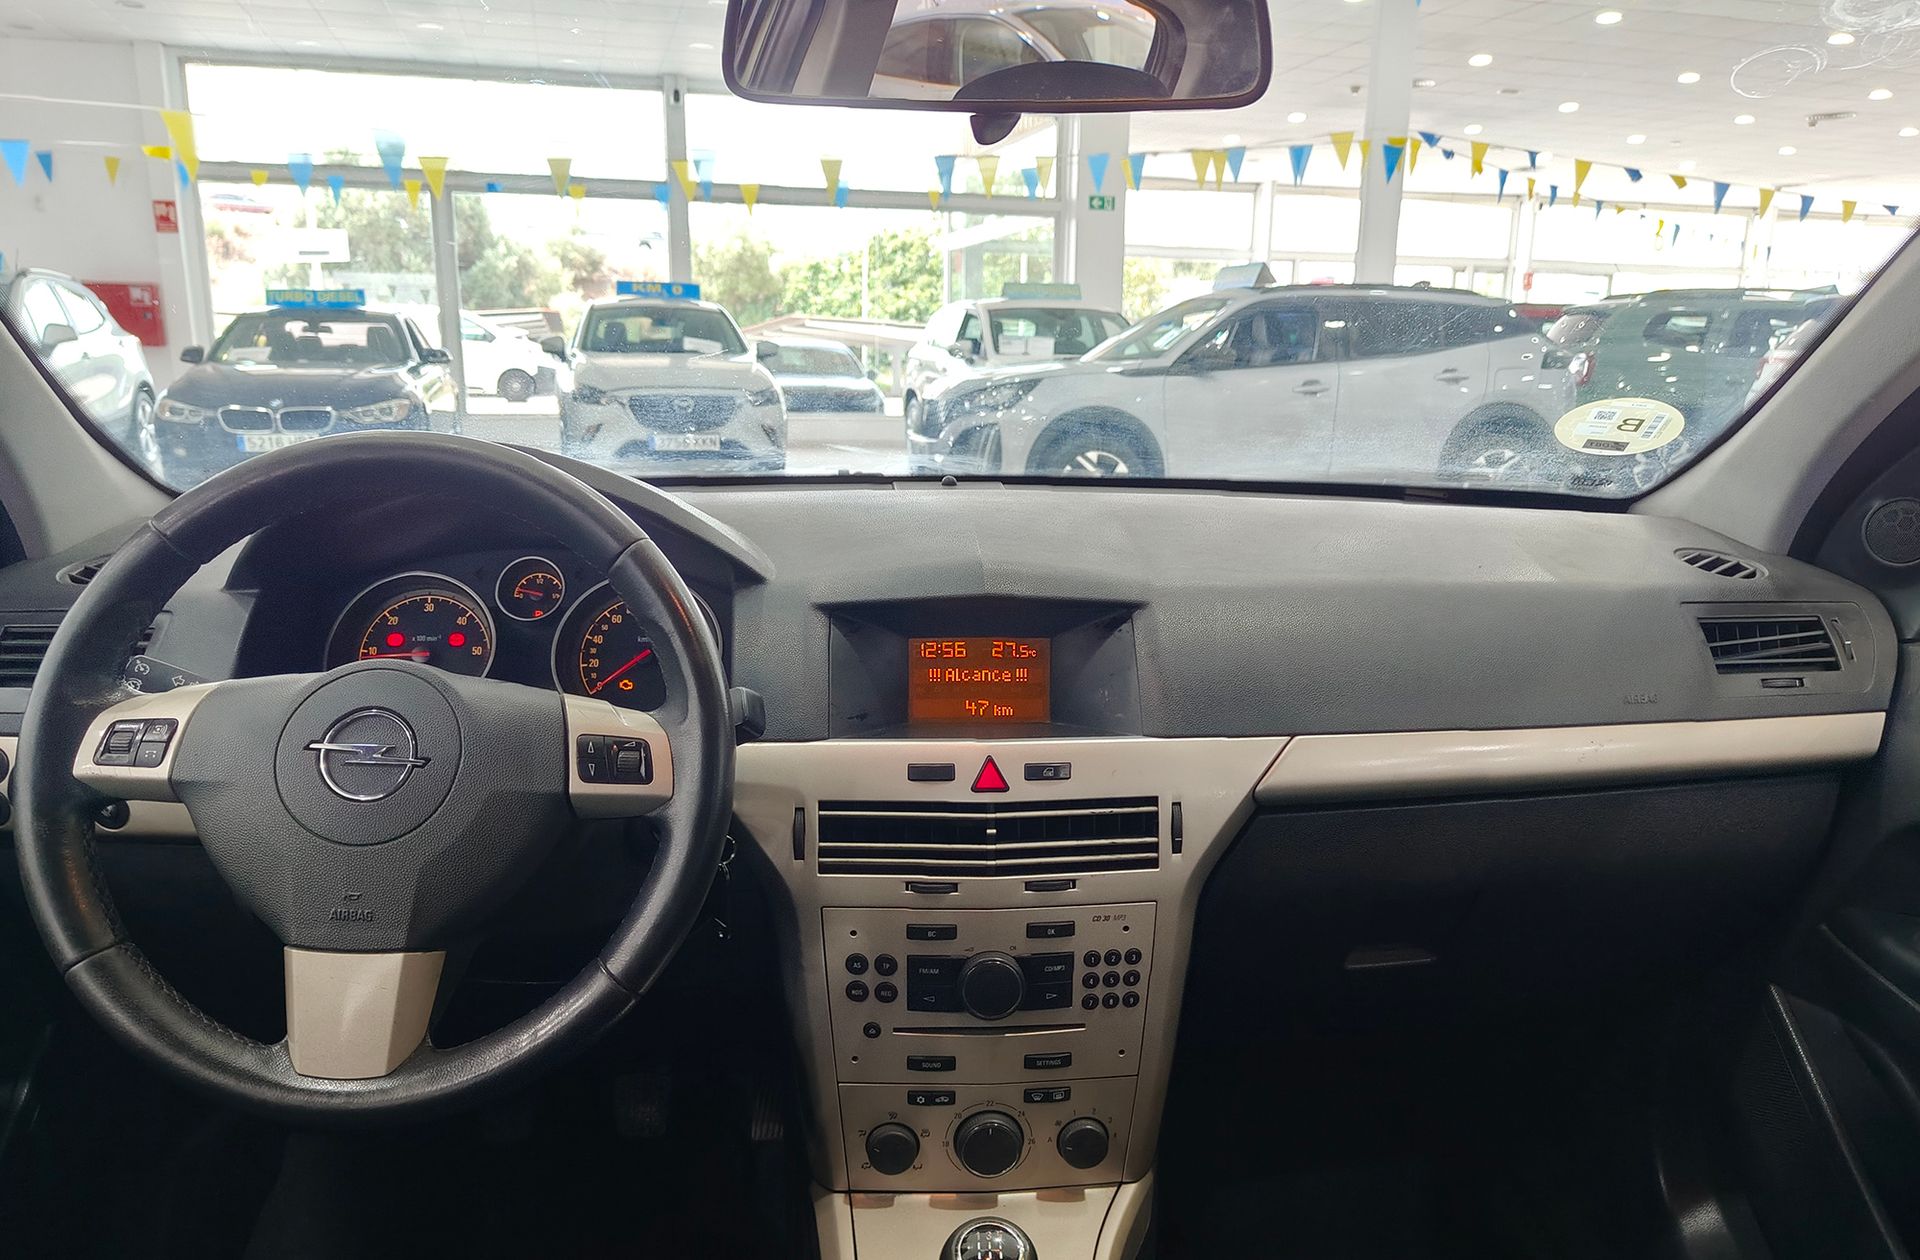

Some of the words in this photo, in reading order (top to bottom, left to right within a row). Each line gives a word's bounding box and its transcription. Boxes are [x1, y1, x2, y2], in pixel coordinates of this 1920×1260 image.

[269, 290, 313, 302] TURBO
[316, 290, 358, 302] DIESEL
[423, 603, 435, 612] 30
[387, 616, 399, 625] 20
[456, 616, 468, 625] 40
[611, 614, 623, 624] 60
[592, 635, 604, 644] 40
[368, 646, 378, 655] 10
[471, 646, 483, 655] 50
[920, 641, 968, 658] 12:56
[588, 658, 599, 668] 20
[945, 668, 1012, 682] Alcance
[965, 700, 989, 716] 47
[993, 704, 1014, 716] km
[329, 908, 373, 921] AIRBAG
[985, 1230, 992, 1240] 3
